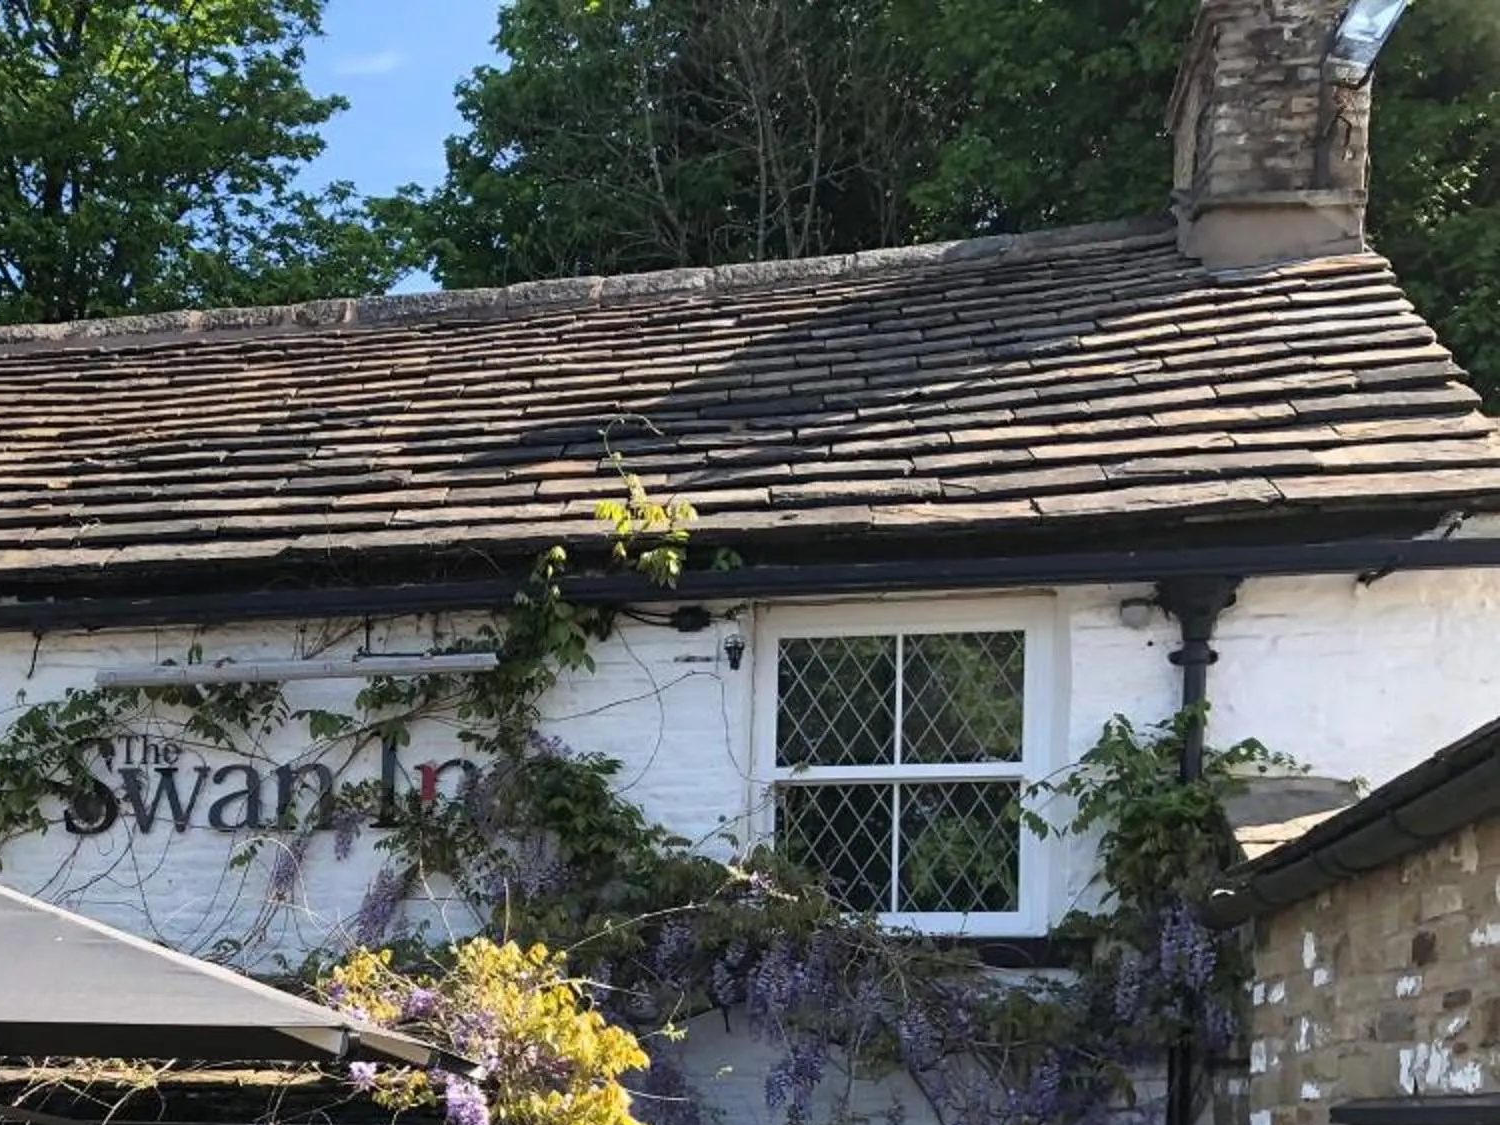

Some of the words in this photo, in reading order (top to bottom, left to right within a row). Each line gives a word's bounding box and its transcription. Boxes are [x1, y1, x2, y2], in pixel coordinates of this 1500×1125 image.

[63, 736, 336, 834] Swan
[369, 728, 496, 829] In
[117, 735, 181, 765] The
